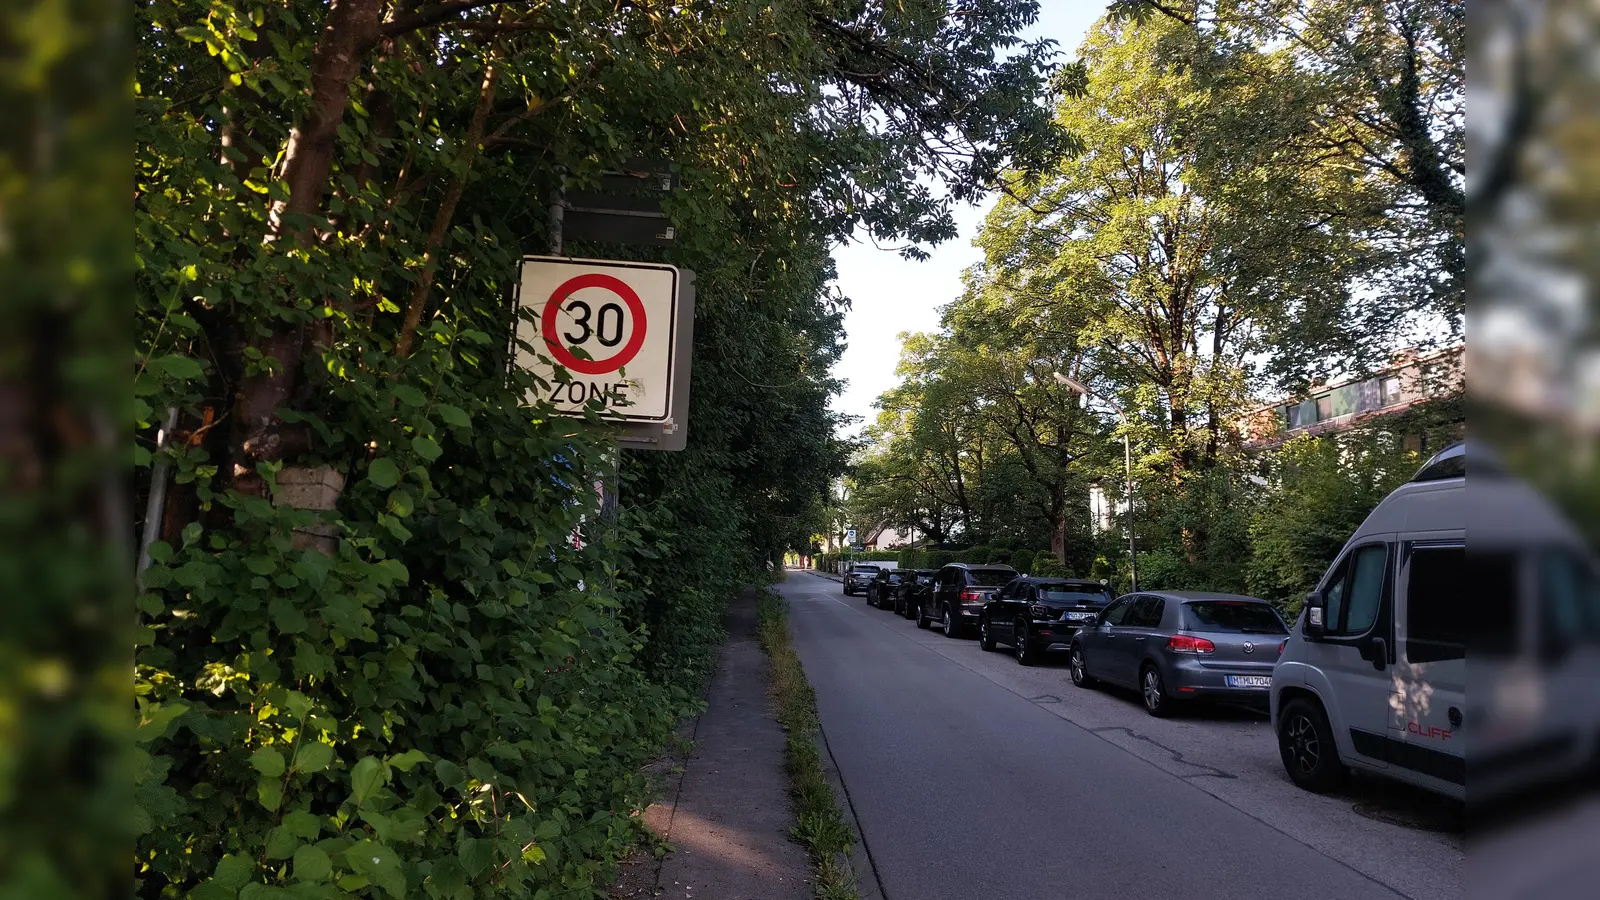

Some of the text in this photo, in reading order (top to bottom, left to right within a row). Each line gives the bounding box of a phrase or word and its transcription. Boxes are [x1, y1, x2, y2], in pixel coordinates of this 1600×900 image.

[564, 301, 624, 347] 30
[549, 380, 629, 407] ZONE
[1408, 721, 1453, 741] CLIFF
